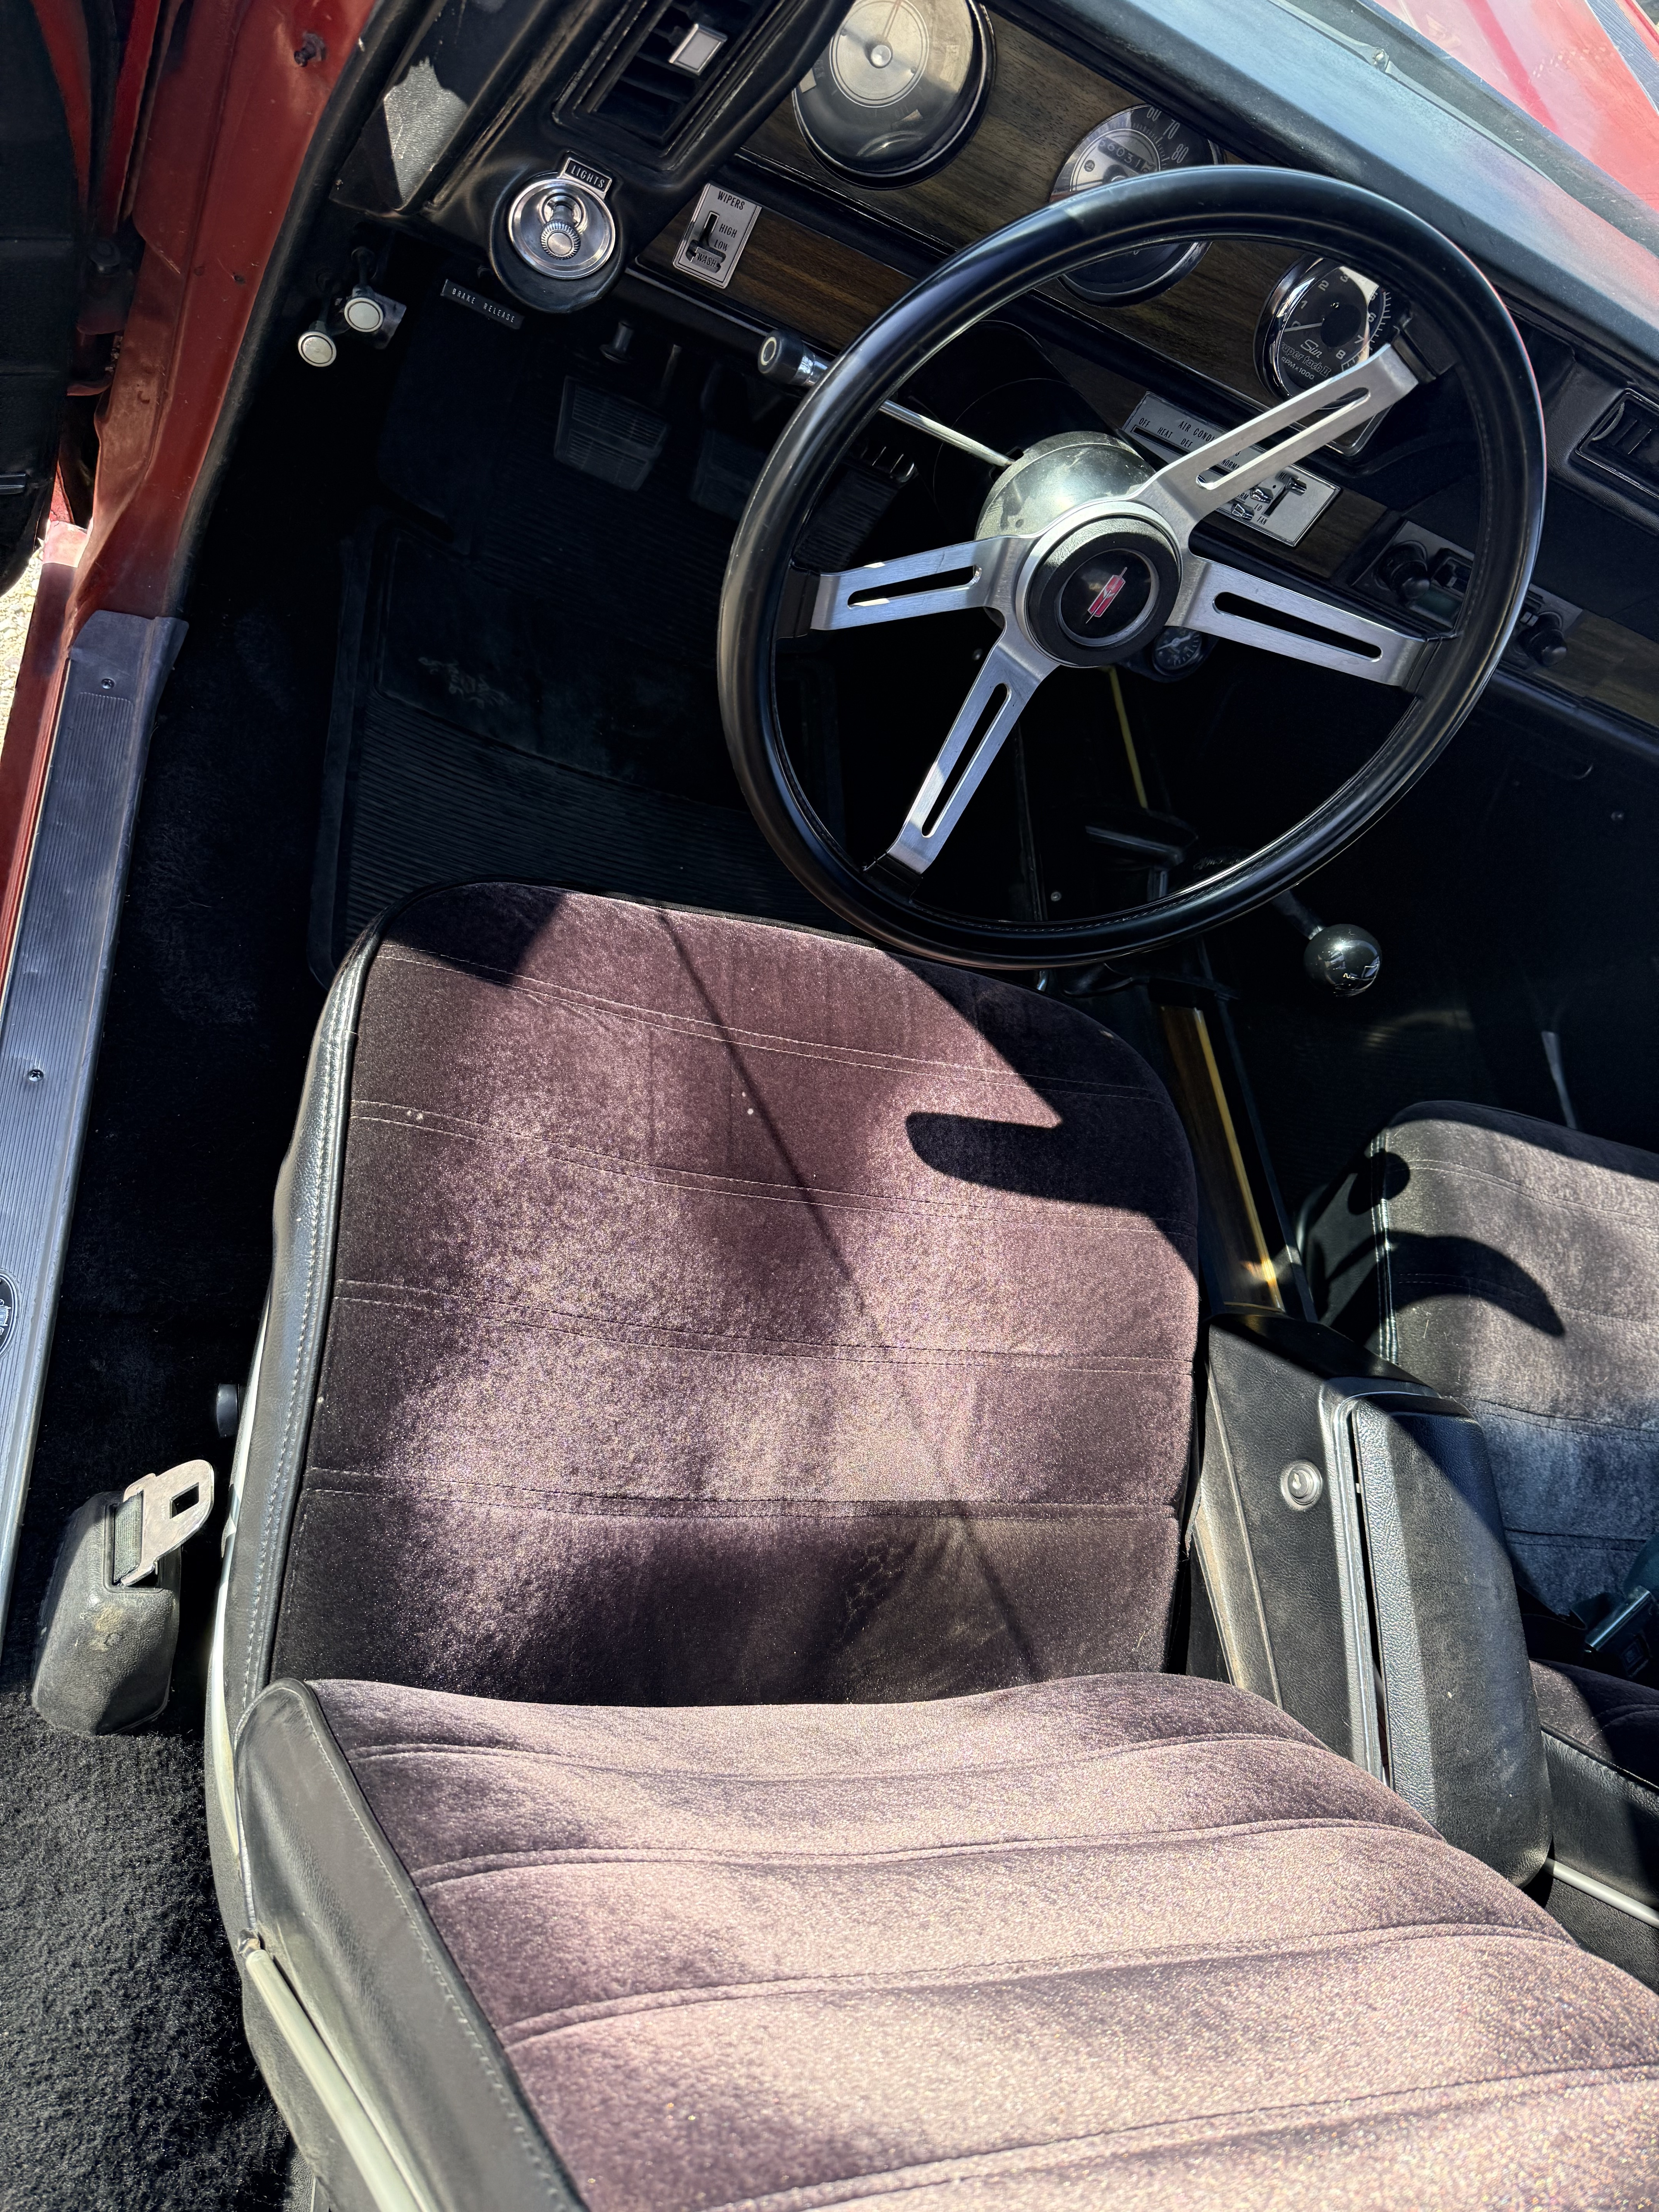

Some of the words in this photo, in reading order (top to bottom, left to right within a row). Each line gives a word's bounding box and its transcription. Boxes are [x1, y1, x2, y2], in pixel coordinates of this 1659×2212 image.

[1163, 119, 1180, 139] 70
[1171, 143, 1189, 163] 80
[571, 165, 605, 188] LIGHTS
[718, 191, 745, 210] WIPERS
[719, 223, 737, 238] HIGH
[714, 240, 728, 251] LOW
[697, 252, 716, 267] WASH
[1318, 280, 1329, 291] 2
[452, 288, 476, 304] BRAKE
[483, 303, 515, 323] RELEASE
[1301, 300, 1308, 309] 1
[1354, 335, 1365, 344] 7
[1300, 339, 1322, 359] Sun
[1336, 349, 1346, 360] 8
[1139, 417, 1151, 428] OFF
[1178, 421, 1192, 432] AIR
[1157, 427, 1173, 438] HEAT
[1180, 438, 1193, 448] DEF
[1279, 472, 1287, 480] HI
[1257, 516, 1268, 526] FAN
